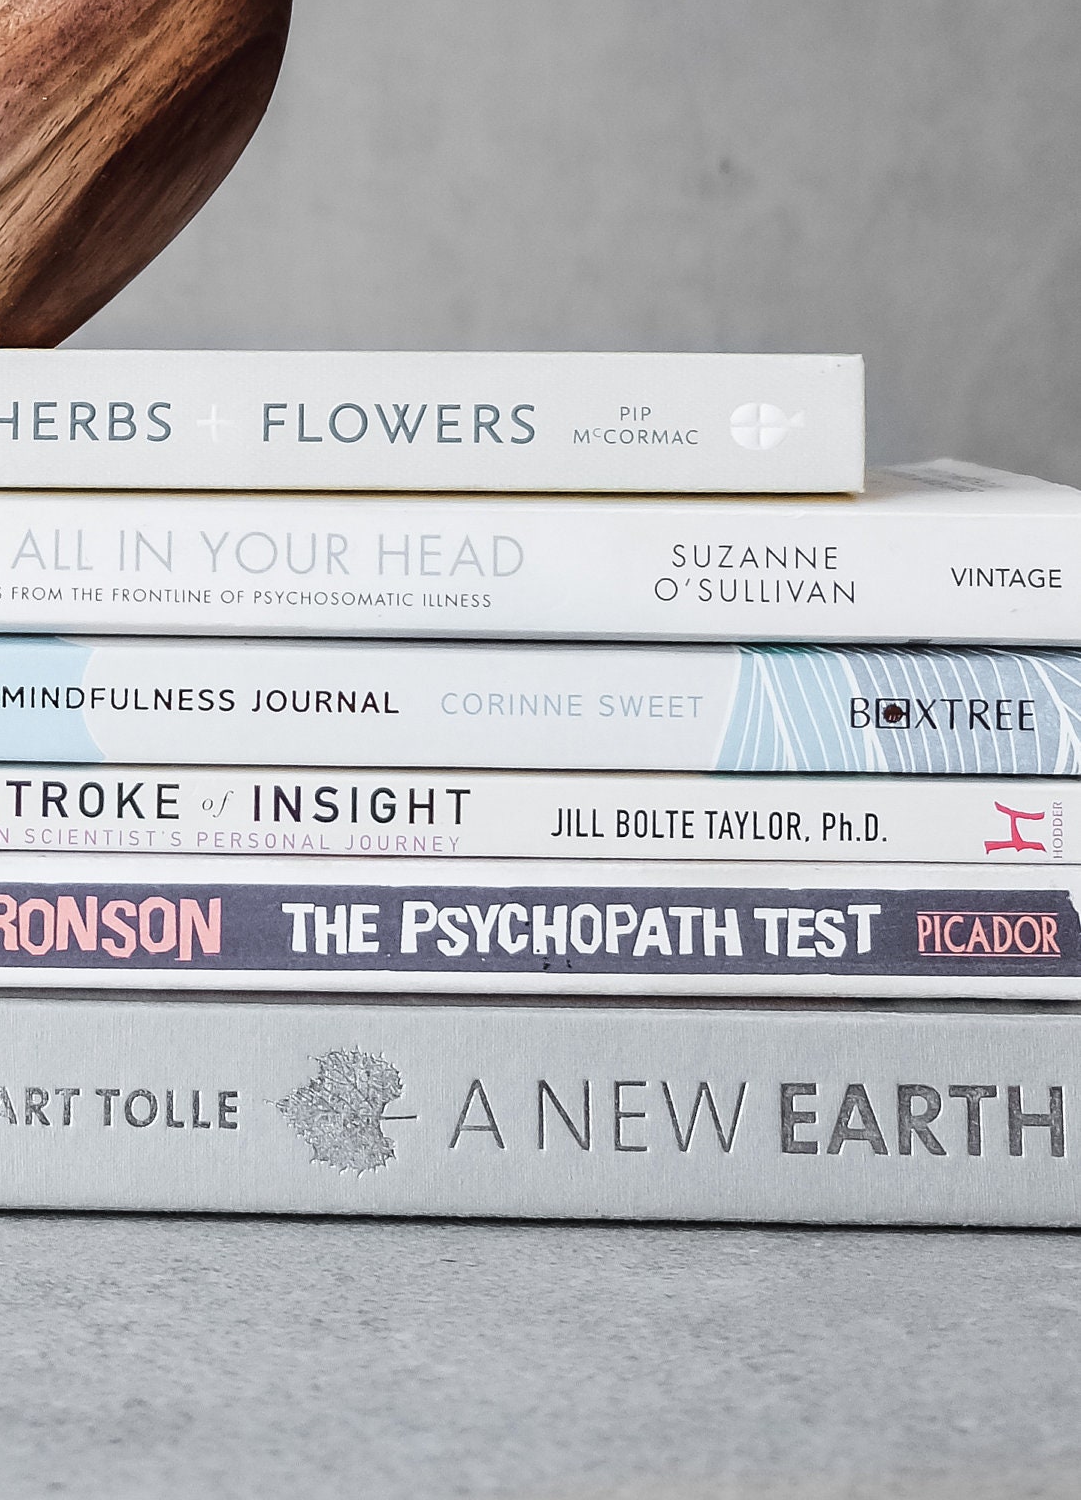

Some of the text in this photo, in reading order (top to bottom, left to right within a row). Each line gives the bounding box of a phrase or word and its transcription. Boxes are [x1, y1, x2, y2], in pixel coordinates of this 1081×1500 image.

[262, 401, 537, 445] FLOWERS
[619, 406, 652, 422] PIP
[10, 527, 94, 572] ALL
[118, 529, 174, 573] IN
[199, 530, 349, 575] YOUR
[377, 534, 525, 577] HEAD
[672, 544, 839, 570] SUZANNE
[654, 578, 856, 604] O'SULLIVAN
[951, 567, 1062, 589] VINTAGE
[11, 585, 63, 602] FROM
[70, 586, 103, 603] THE
[112, 587, 213, 604] FRONTLINE
[221, 589, 247, 605] OF
[253, 590, 415, 607] PSYCHOSOMATIC
[423, 591, 492, 608] ILLNESS
[1, 685, 236, 712] MINDFULNESS
[251, 689, 400, 715] JOURNAL
[440, 692, 703, 718] CORINNE SWEET
[201, 790, 236, 818] of
[253, 784, 471, 826] INSIGHT
[25, 828, 182, 847] SCIENTIST'S
[196, 831, 331, 850] PERSONAL
[344, 834, 459, 853] JOURNEY
[551, 808, 888, 843] JILL BOLTE TAYLOR, Ph.D.
[1052, 801, 1063, 859] HODDER
[281, 901, 881, 958] THE PSYCHOPATH TEST
[917, 911, 1060, 956] PICADOR
[95, 1087, 239, 1130] TOLLE
[450, 1079, 1065, 1158] A NEW EARTH
